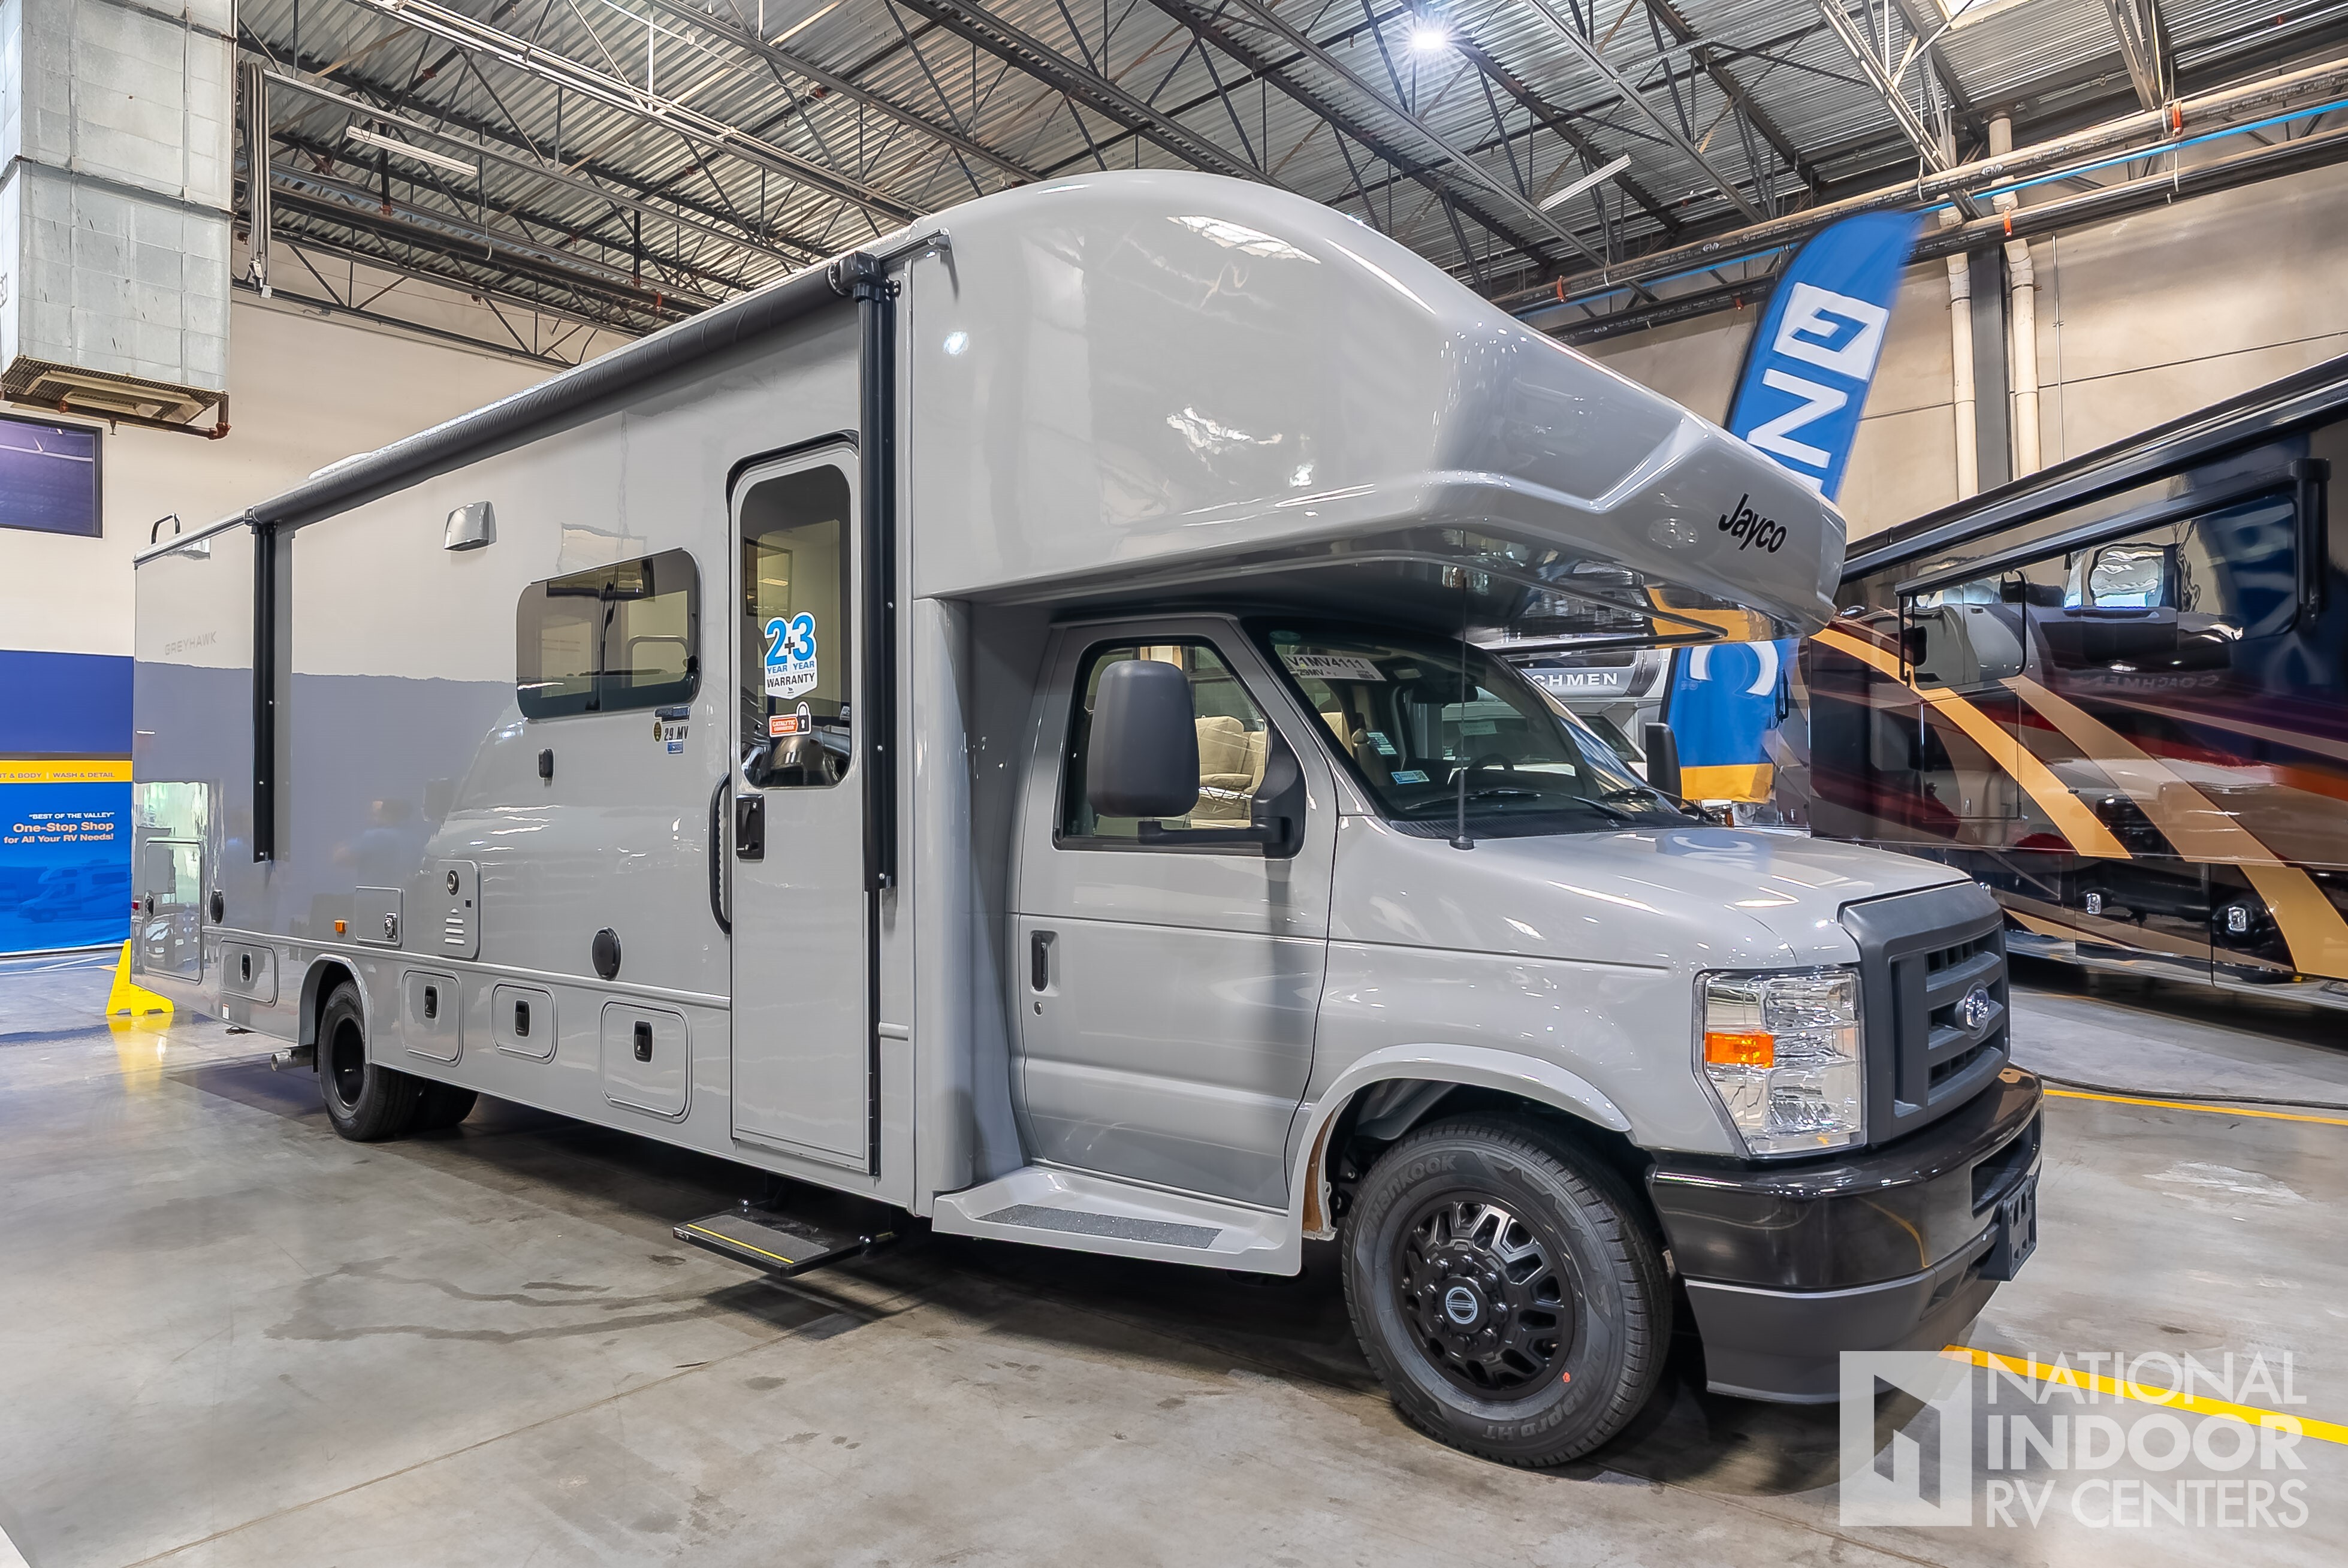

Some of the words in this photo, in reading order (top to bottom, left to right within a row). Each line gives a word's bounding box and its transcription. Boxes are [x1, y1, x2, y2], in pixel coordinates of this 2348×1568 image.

[1718, 492, 1787, 554] Jayco
[164, 630, 217, 656] GREYHAWK
[766, 664, 788, 675] YEAR
[792, 660, 815, 670] YEAR
[766, 672, 815, 688] WARRANTY
[663, 727, 674, 741] 29
[677, 725, 689, 739] MV
[13, 822, 78, 833] One-Stop
[80, 821, 114, 832] Shop
